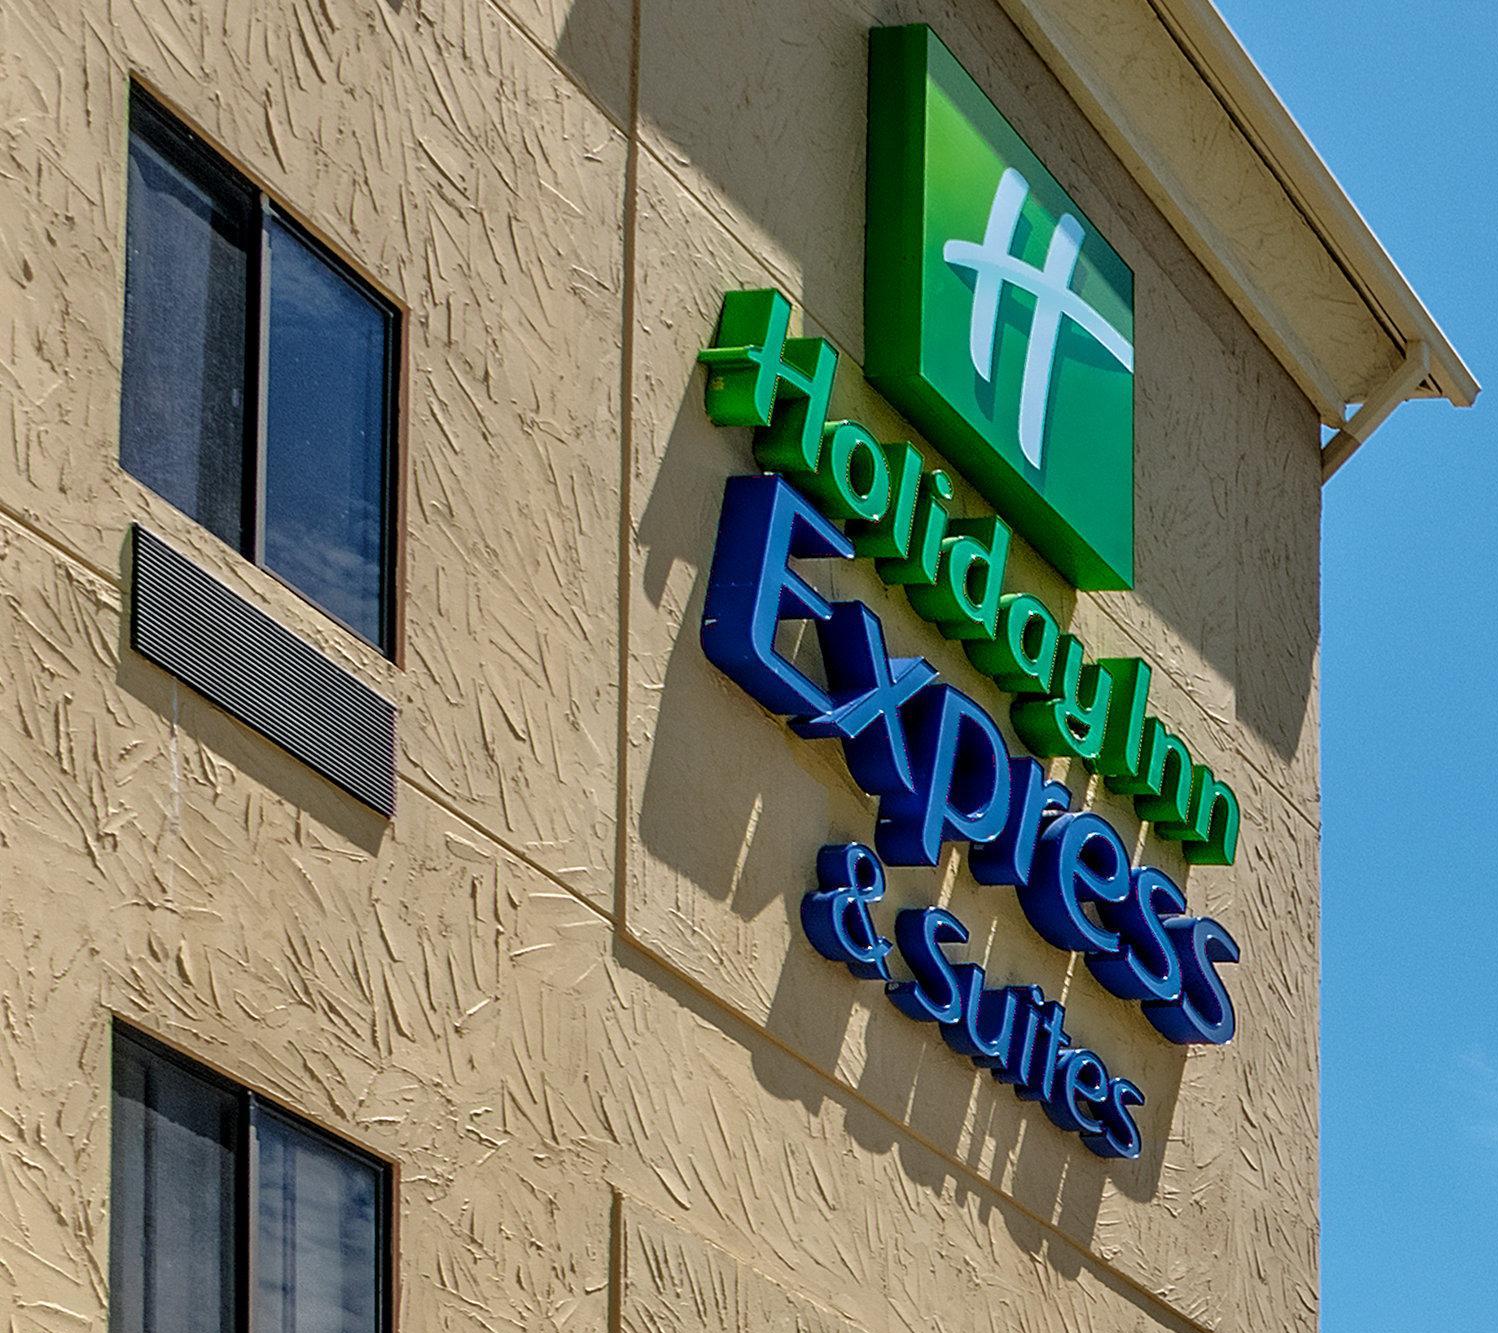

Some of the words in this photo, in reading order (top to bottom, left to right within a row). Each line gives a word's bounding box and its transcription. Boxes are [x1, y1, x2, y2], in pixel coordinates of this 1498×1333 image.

[699, 288, 1113, 760] Holiday
[1096, 657, 1241, 866] Inn
[701, 474, 1240, 1045] Express
[801, 842, 894, 981] &
[886, 905, 1146, 1159] Suites
